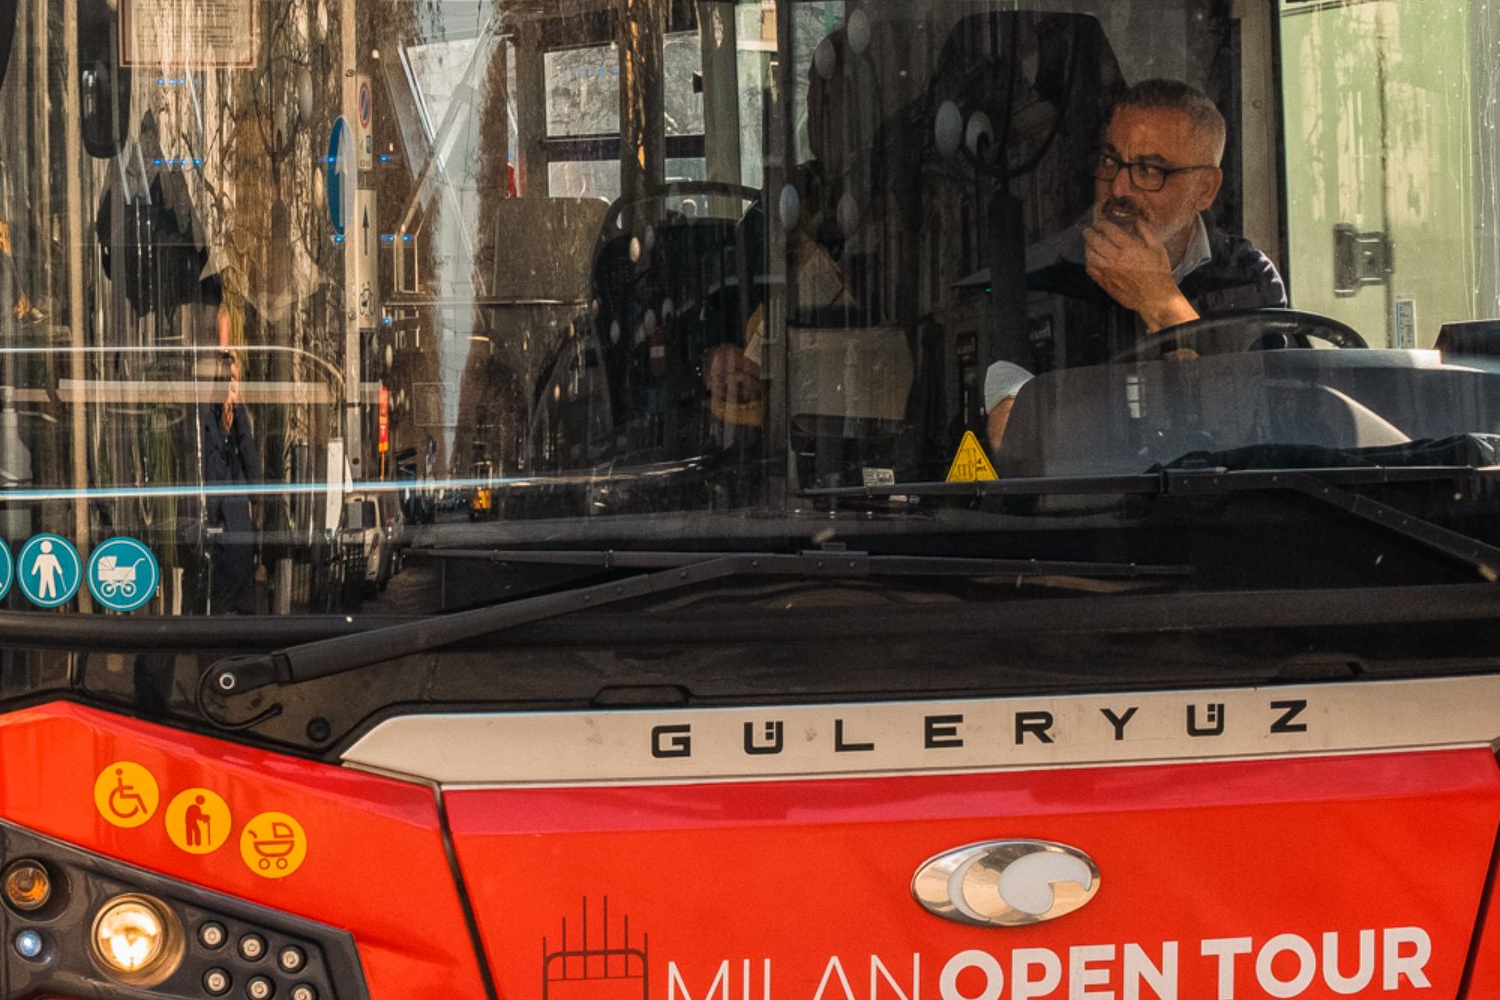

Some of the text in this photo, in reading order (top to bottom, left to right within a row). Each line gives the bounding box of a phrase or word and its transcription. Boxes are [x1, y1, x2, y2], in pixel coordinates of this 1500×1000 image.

[650, 698, 1308, 759] GÜLERYÜZ
[938, 940, 1179, 1000] OPEN
[1200, 925, 1432, 1000] TOUR
